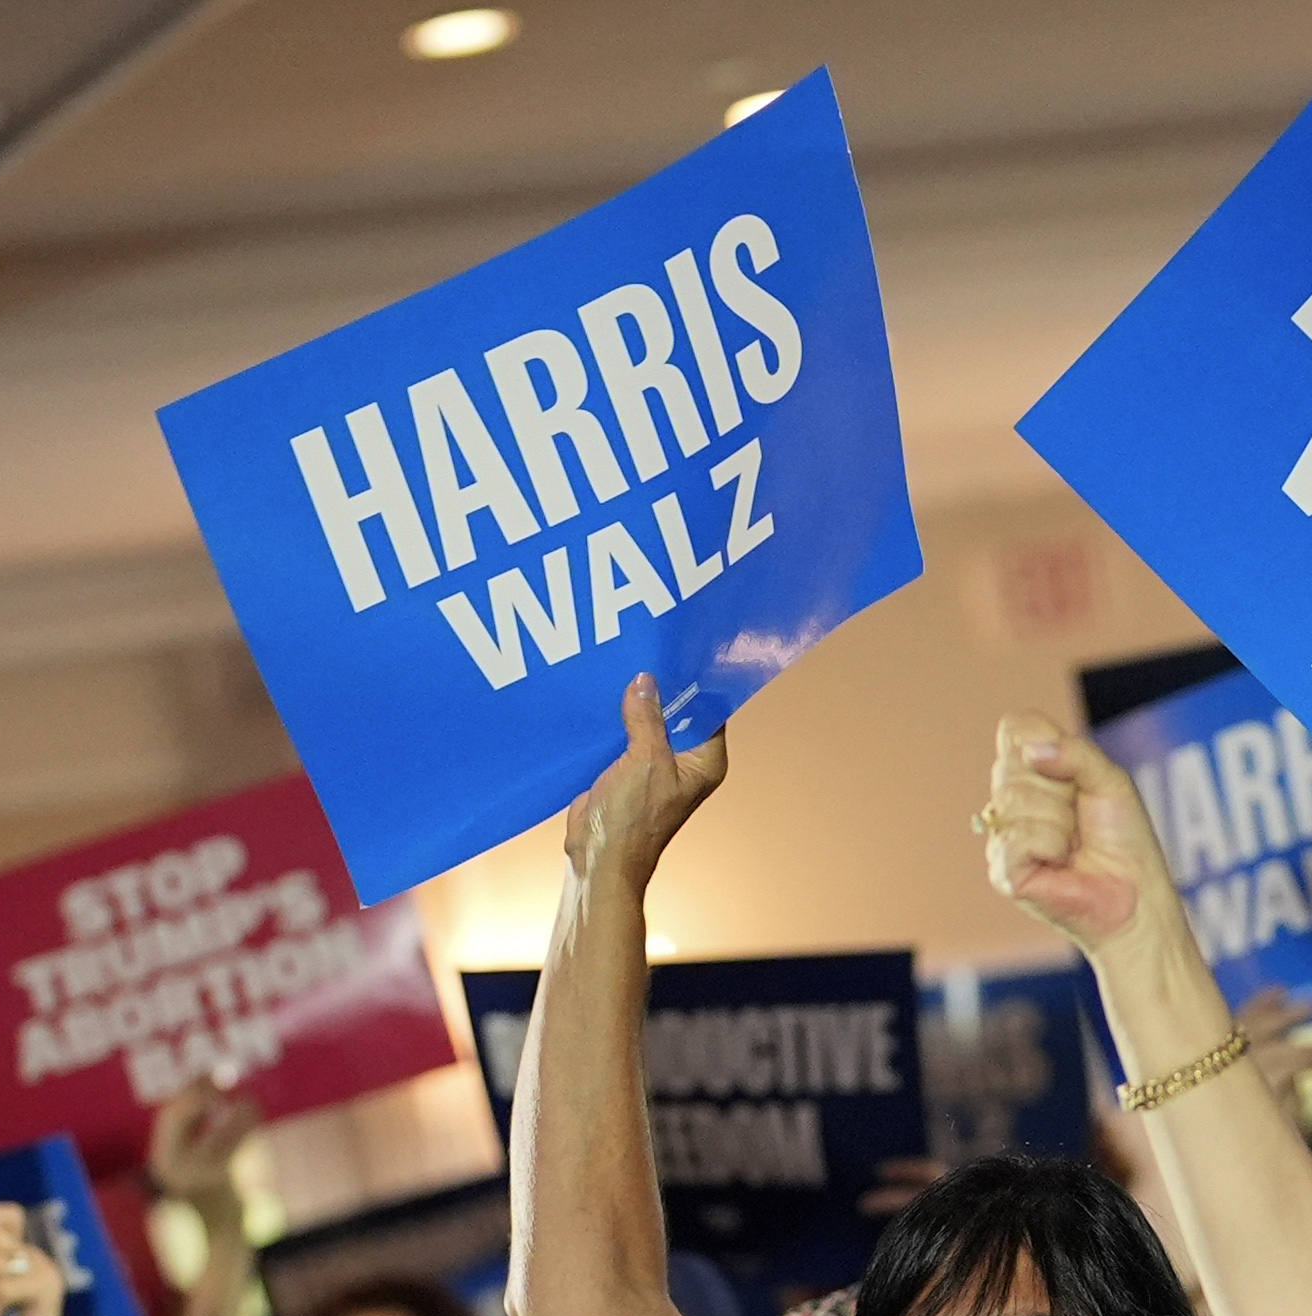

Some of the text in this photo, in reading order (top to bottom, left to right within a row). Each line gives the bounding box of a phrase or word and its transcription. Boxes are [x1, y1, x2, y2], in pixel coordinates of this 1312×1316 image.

[290, 213, 803, 613] HARRIS
[436, 438, 775, 691] WALZ
[57, 834, 250, 942] STOP
